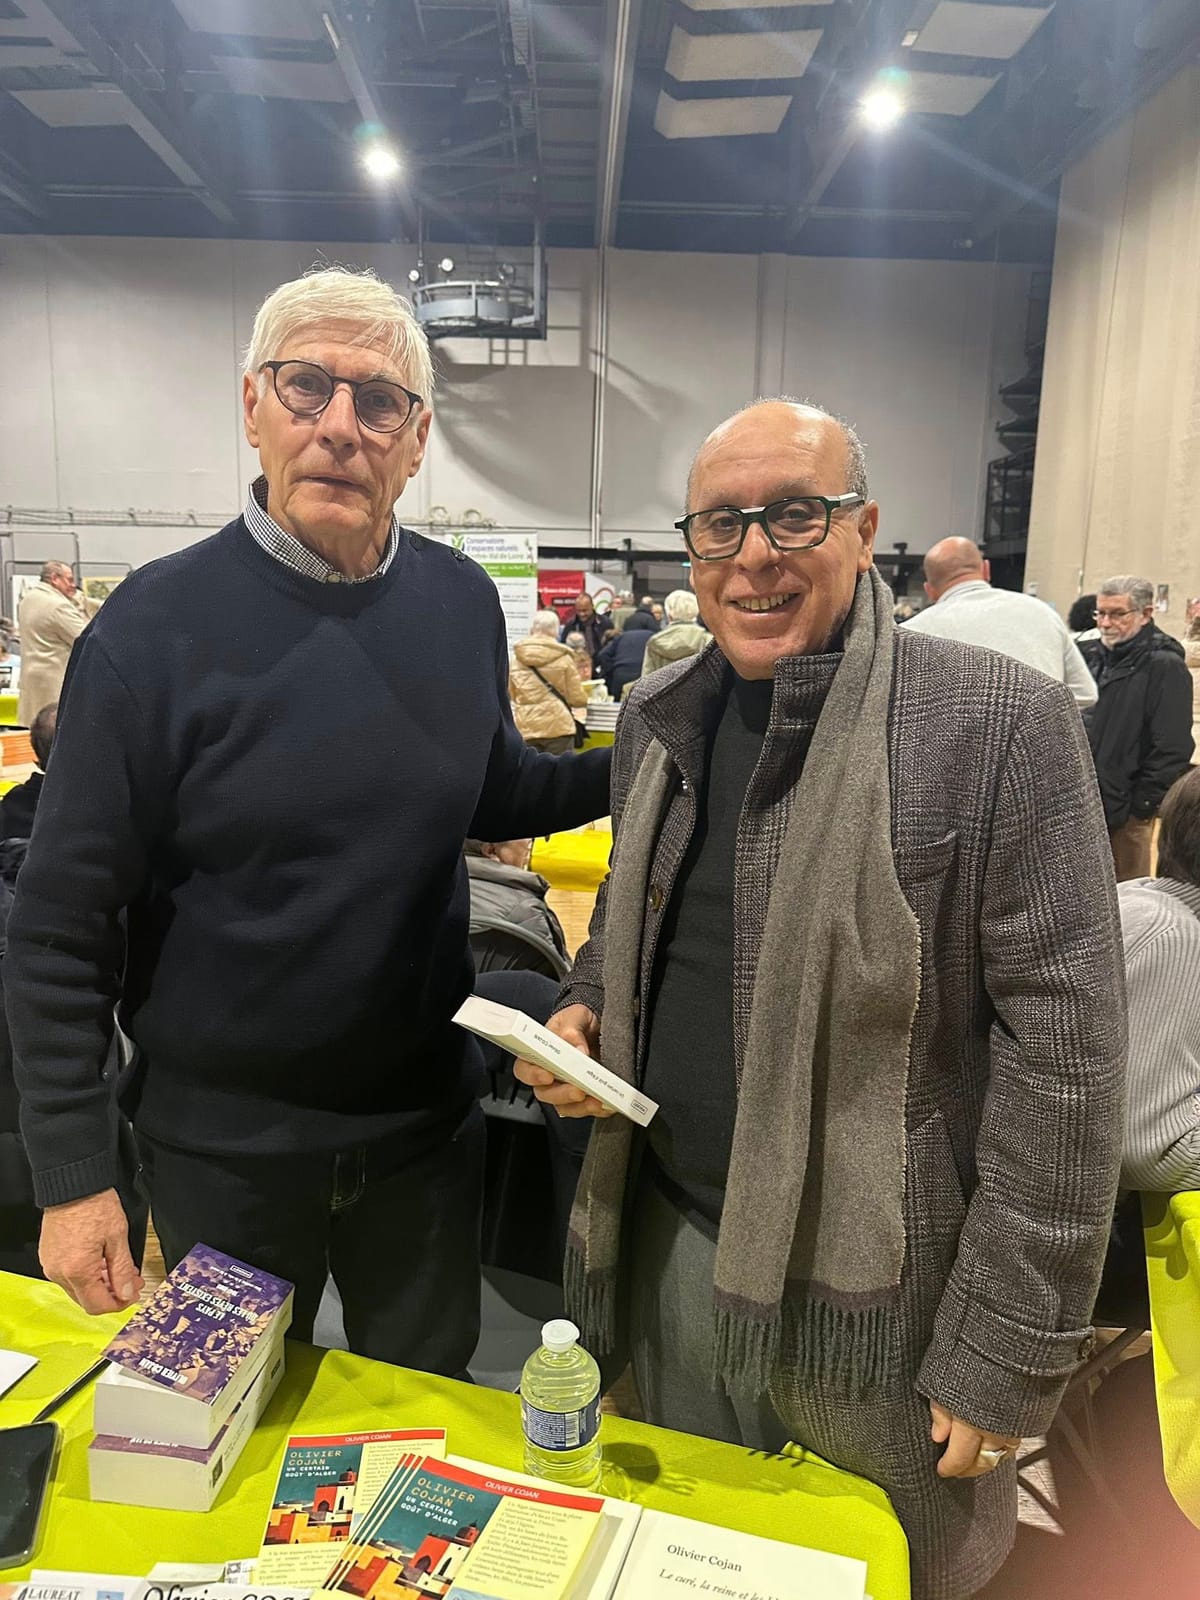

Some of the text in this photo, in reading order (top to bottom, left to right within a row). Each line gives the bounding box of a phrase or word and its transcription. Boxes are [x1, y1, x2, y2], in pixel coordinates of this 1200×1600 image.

[177, 1281, 213, 1303] EXISTENT
[195, 1303, 226, 1321] LE PAYS
[210, 1296, 235, 1312] RÊVES
[232, 1306, 247, 1319] LES
[290, 1450, 342, 1459] OLIVIER
[411, 1487, 454, 1507] COJAN
[417, 1477, 476, 1503] OLIVIER
[485, 1480, 541, 1499] OLIVIER COJAN
[400, 1502, 459, 1527] GOÛT D'ALGER
[405, 1495, 454, 1516] UN CERTAIN
[667, 1544, 743, 1573] Olivier Cojan
[143, 1584, 234, 1600] Oliv
[659, 1568, 674, 1580] Le
[675, 1575, 697, 1588] curé,
[700, 1580, 711, 1590] la
[712, 1585, 737, 1598] reine
[738, 1591, 749, 1600] et
